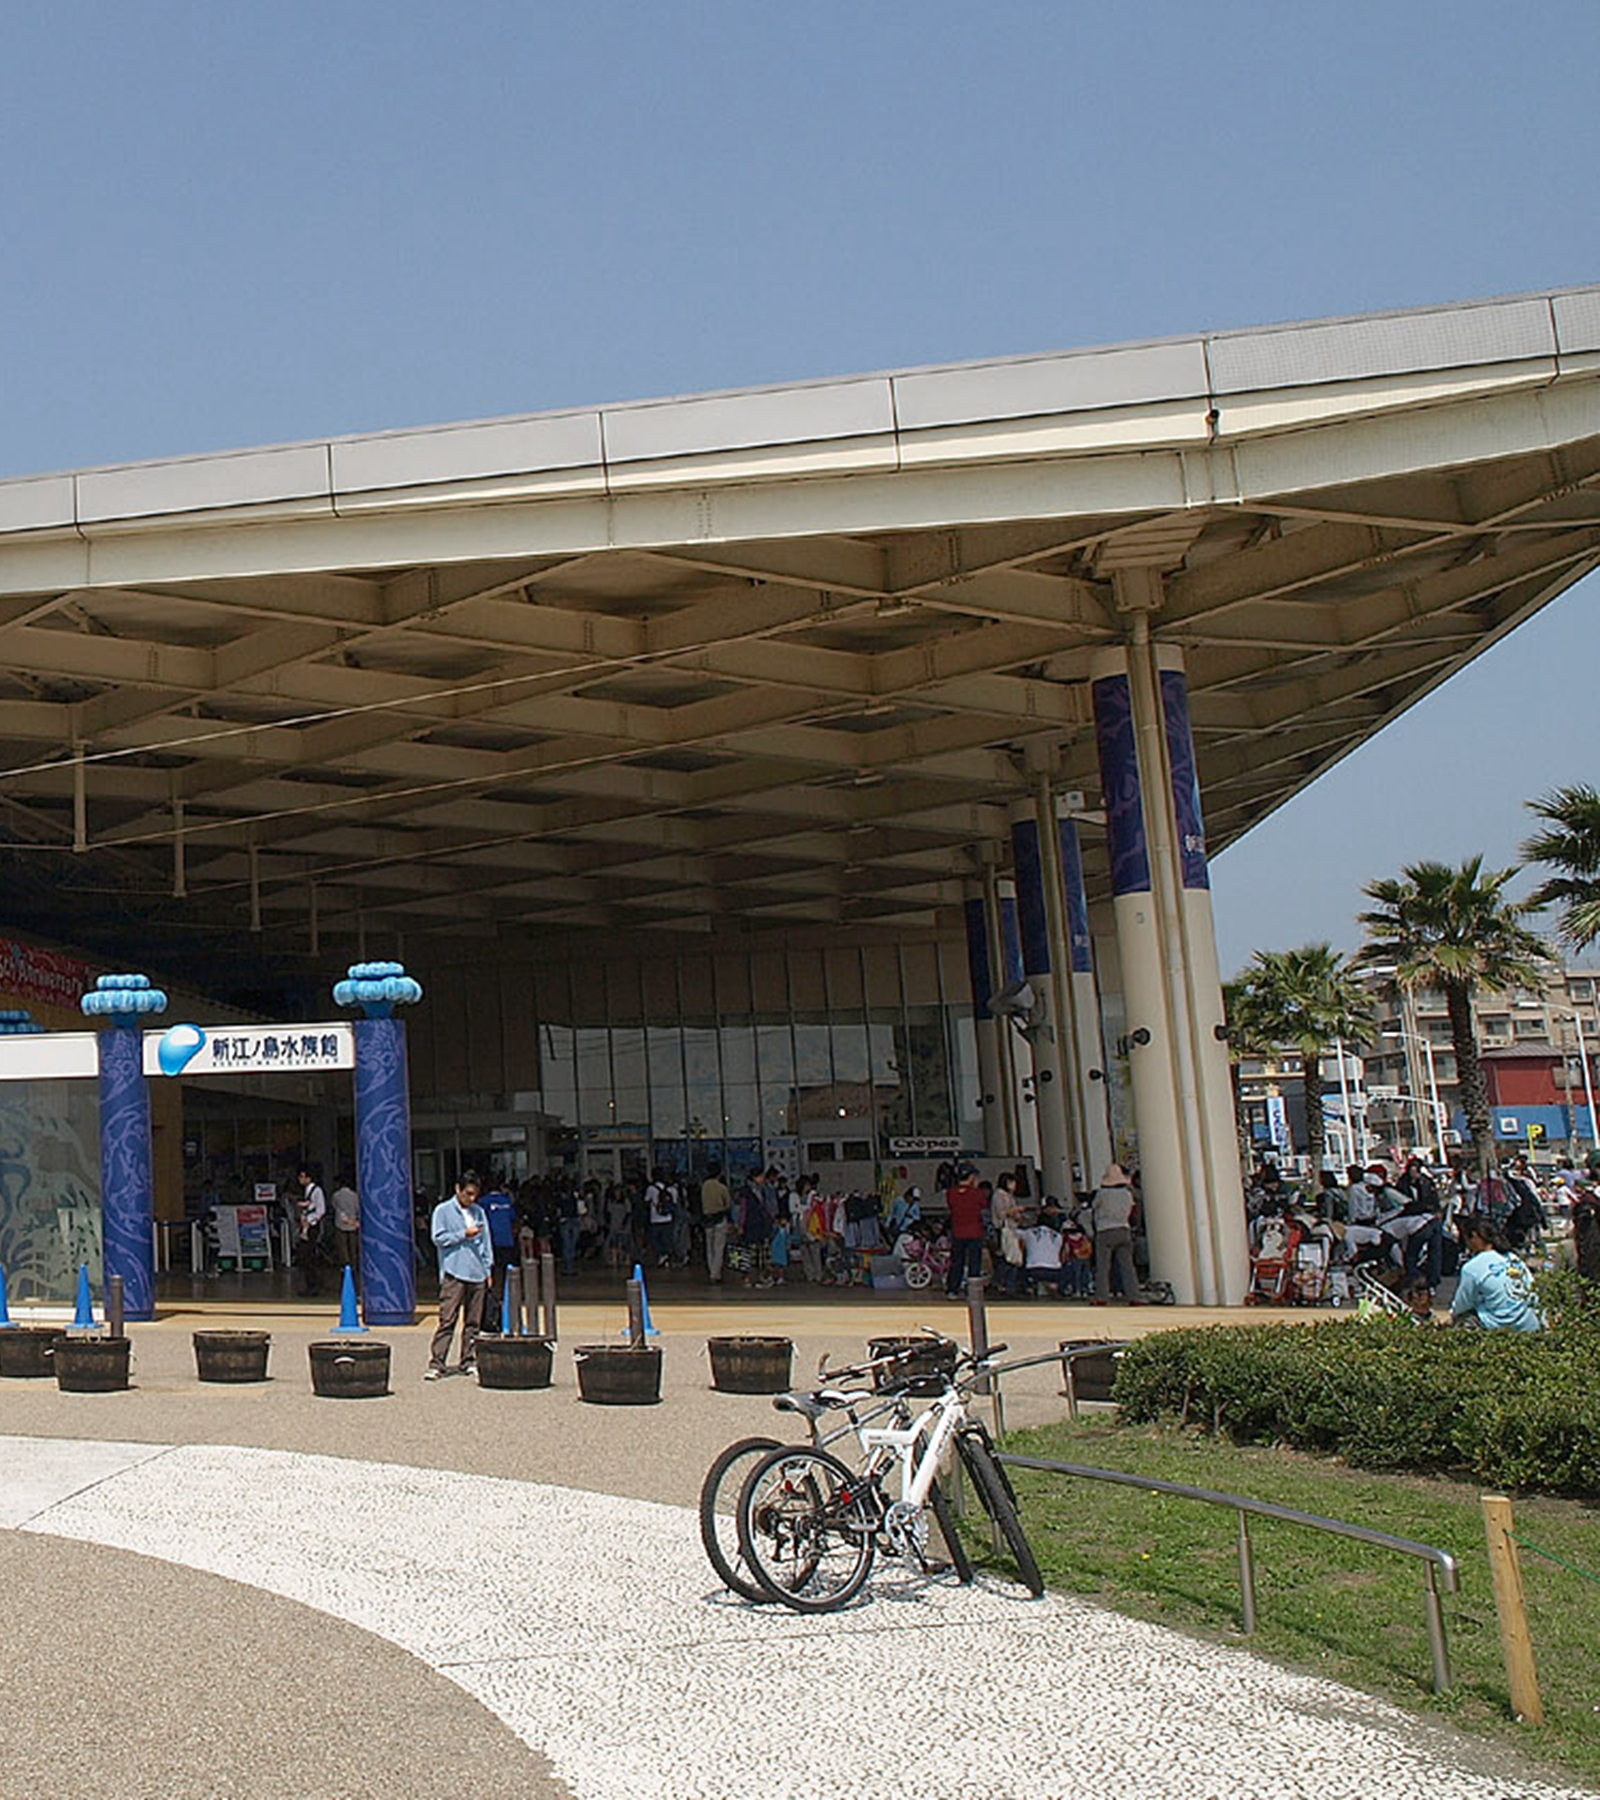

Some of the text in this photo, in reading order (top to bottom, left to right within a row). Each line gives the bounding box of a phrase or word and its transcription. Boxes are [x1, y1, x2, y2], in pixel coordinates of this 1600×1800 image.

[213, 1034, 338, 1060] 新江ノ島水族館
